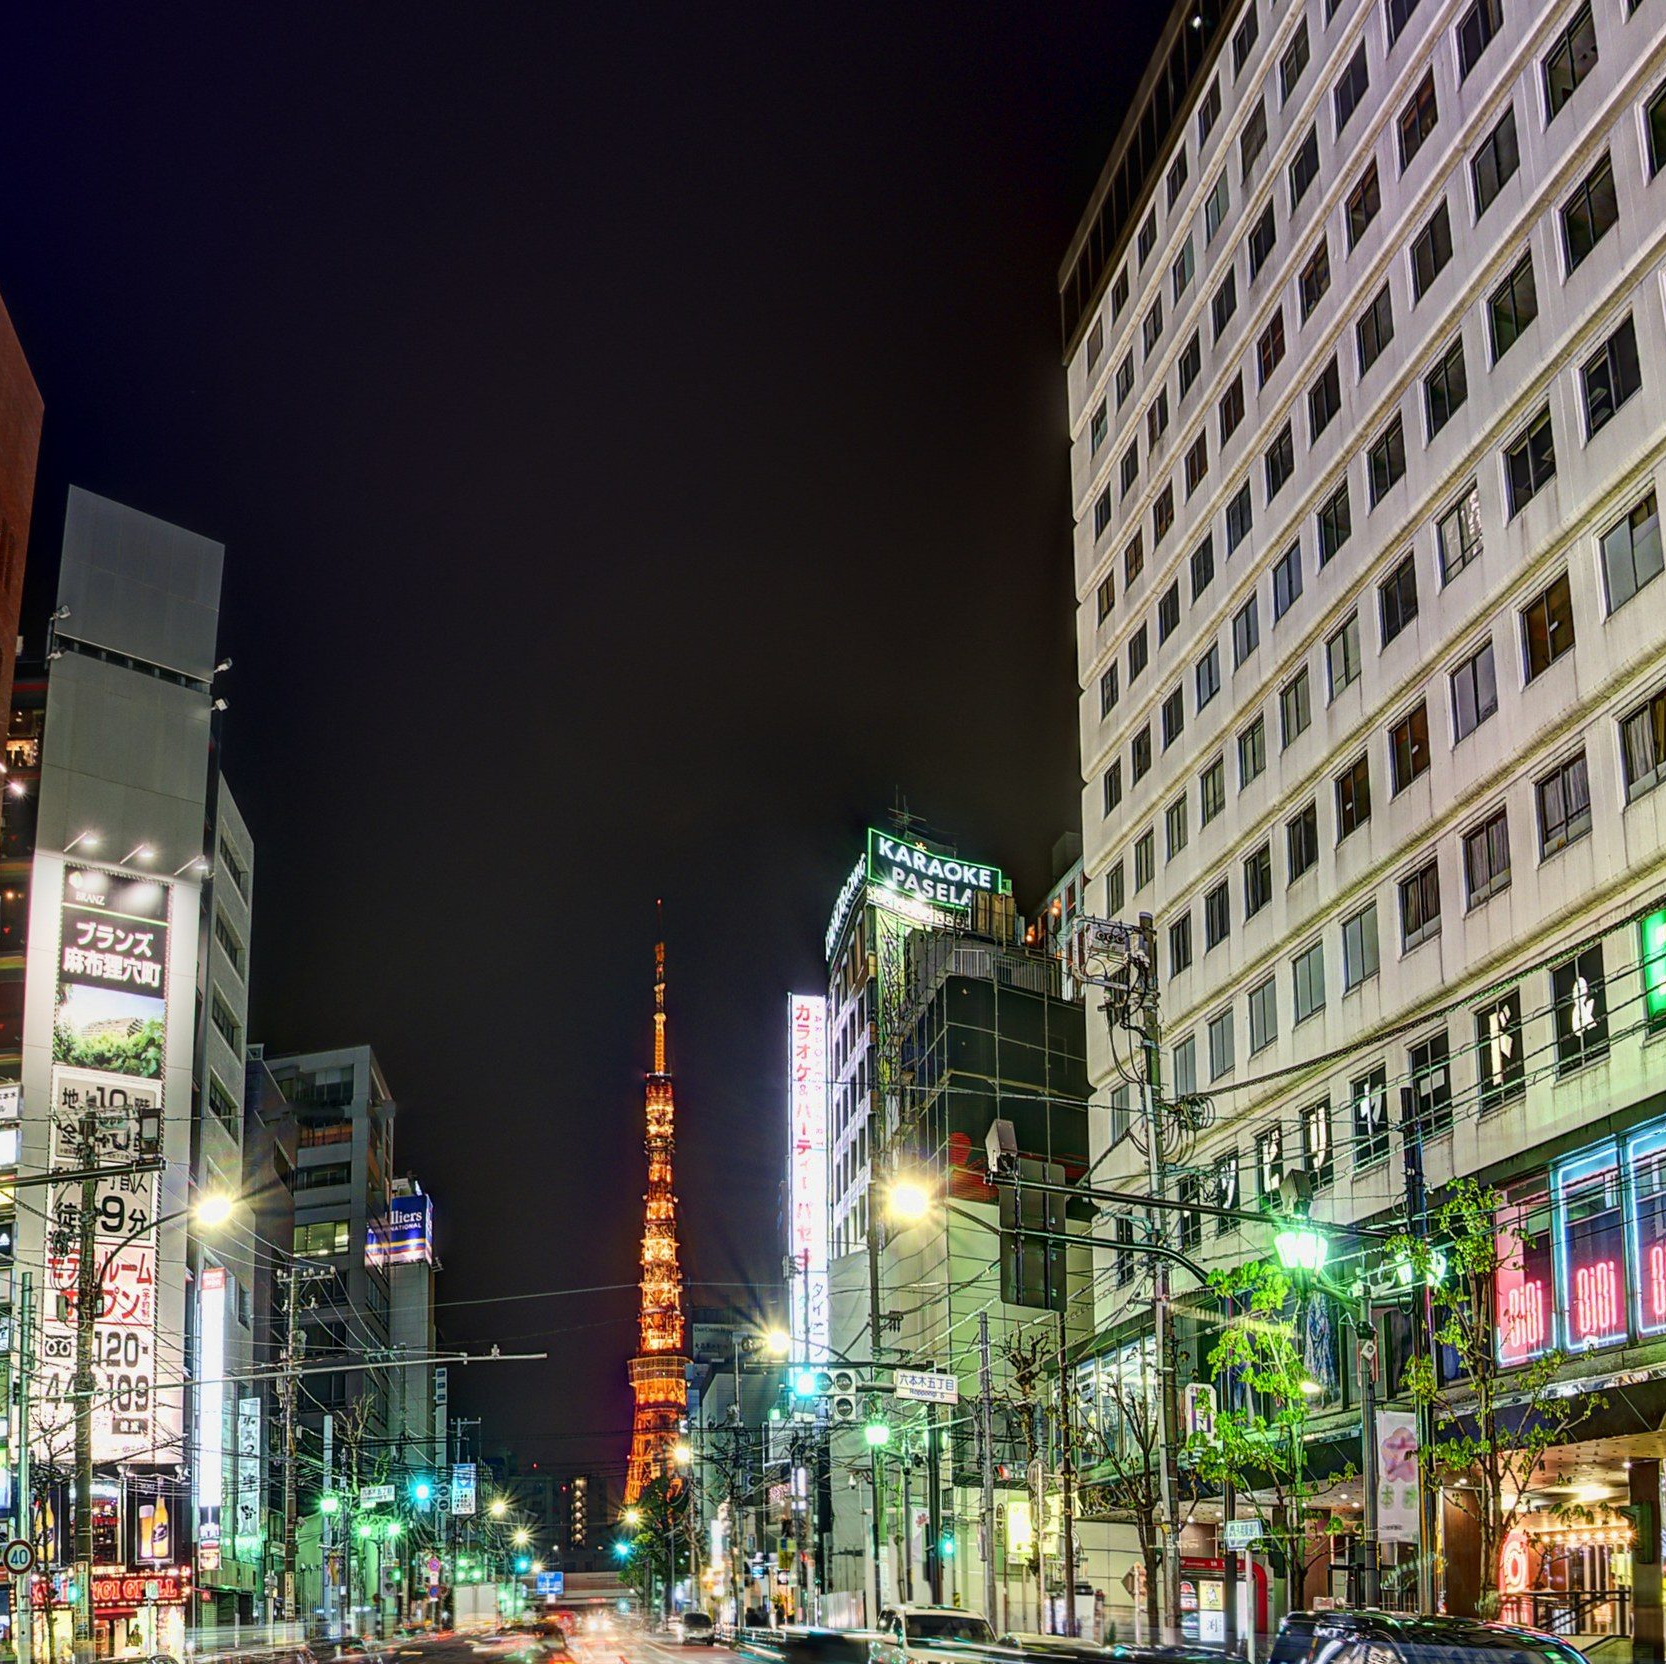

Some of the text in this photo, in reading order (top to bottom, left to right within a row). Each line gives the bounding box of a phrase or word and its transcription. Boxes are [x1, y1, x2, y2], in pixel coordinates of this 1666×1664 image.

[879, 836, 991, 888] KARAOKE
[77, 922, 153, 957] ブランズ
[63, 947, 161, 987] 麻布狸穴町
[390, 1209, 423, 1225] lliers
[899, 1373, 954, 1391] 六本木五丁目
[11, 1549, 28, 1565] 40
